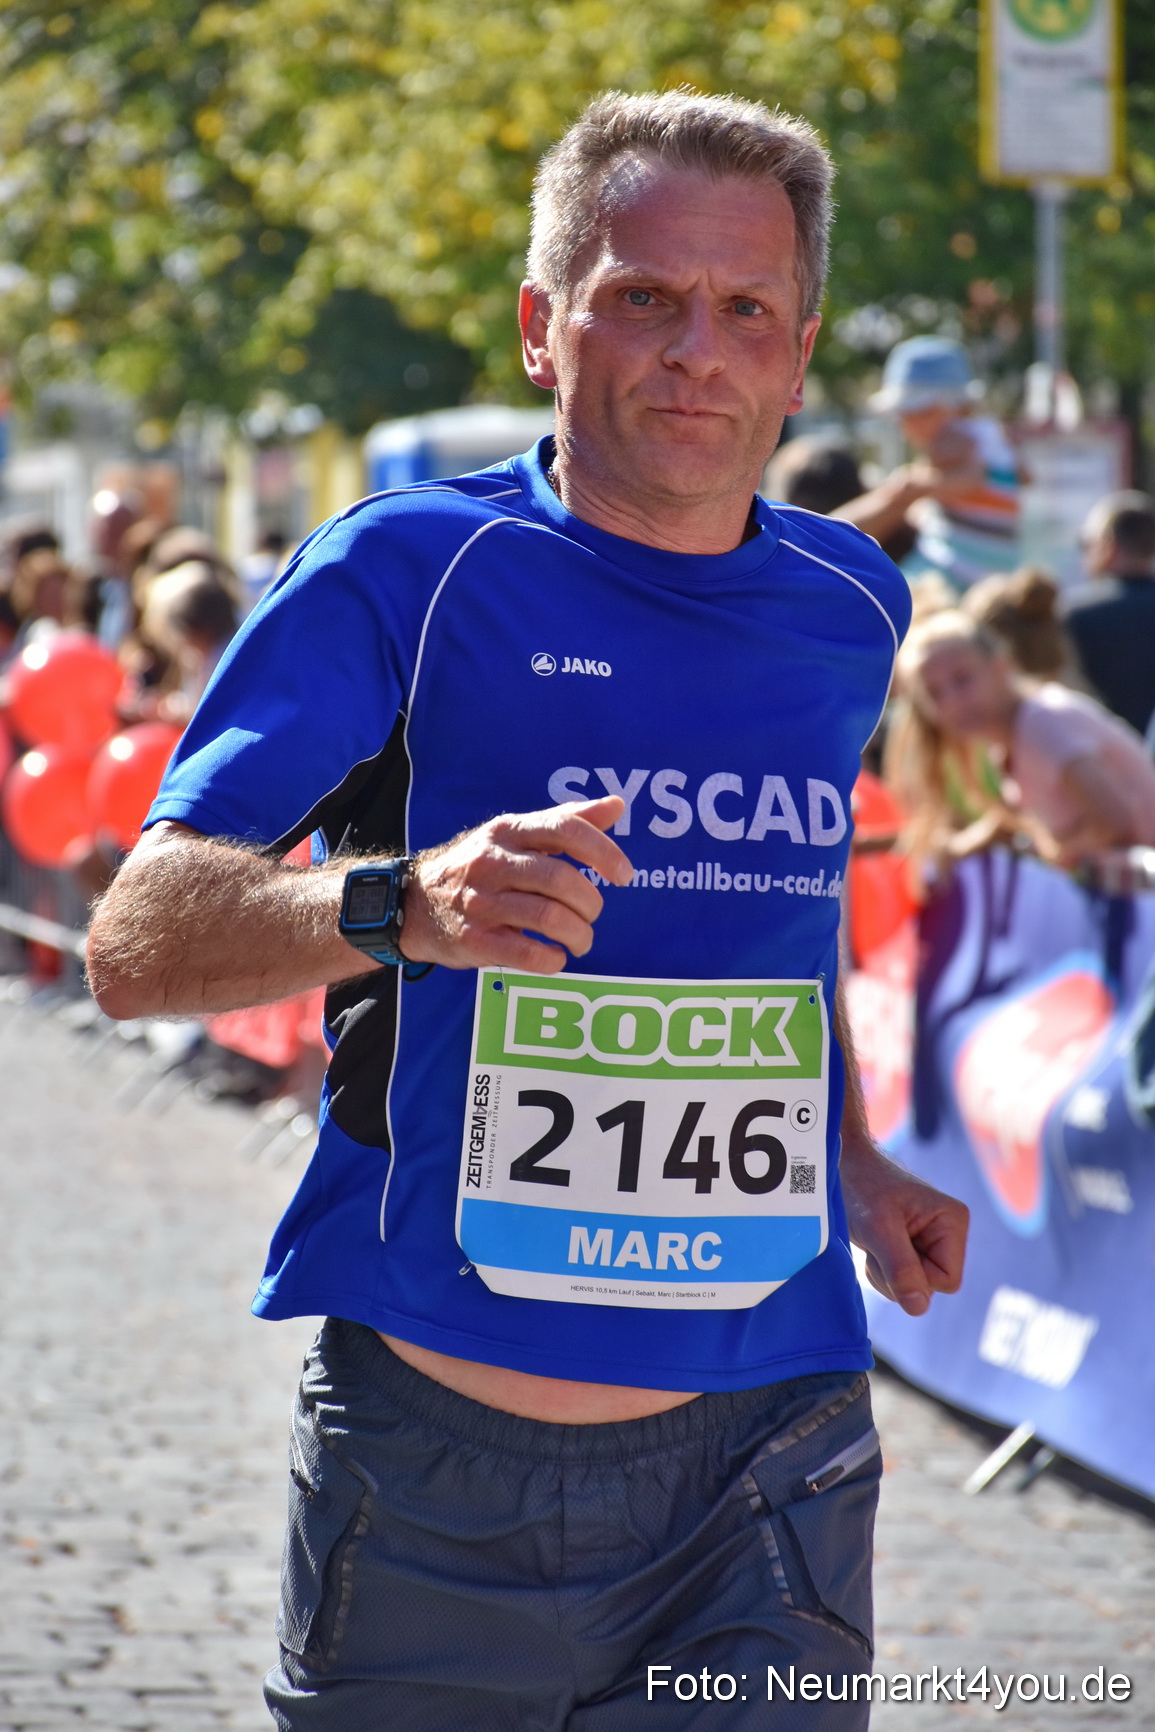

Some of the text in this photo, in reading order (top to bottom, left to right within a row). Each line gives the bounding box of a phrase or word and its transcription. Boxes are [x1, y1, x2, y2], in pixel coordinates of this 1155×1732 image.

[561, 656, 612, 677] JAKO
[547, 766, 847, 847] SYSCAD
[508, 991, 795, 1062] BOCK
[486, 1074, 502, 1189] TRANSPONDER ZEITMESSUNG
[509, 1089, 787, 1195] 2146
[796, 1107, 811, 1125] C
[567, 1225, 723, 1271] MARC
[570, 1285, 594, 1293] HERVIS
